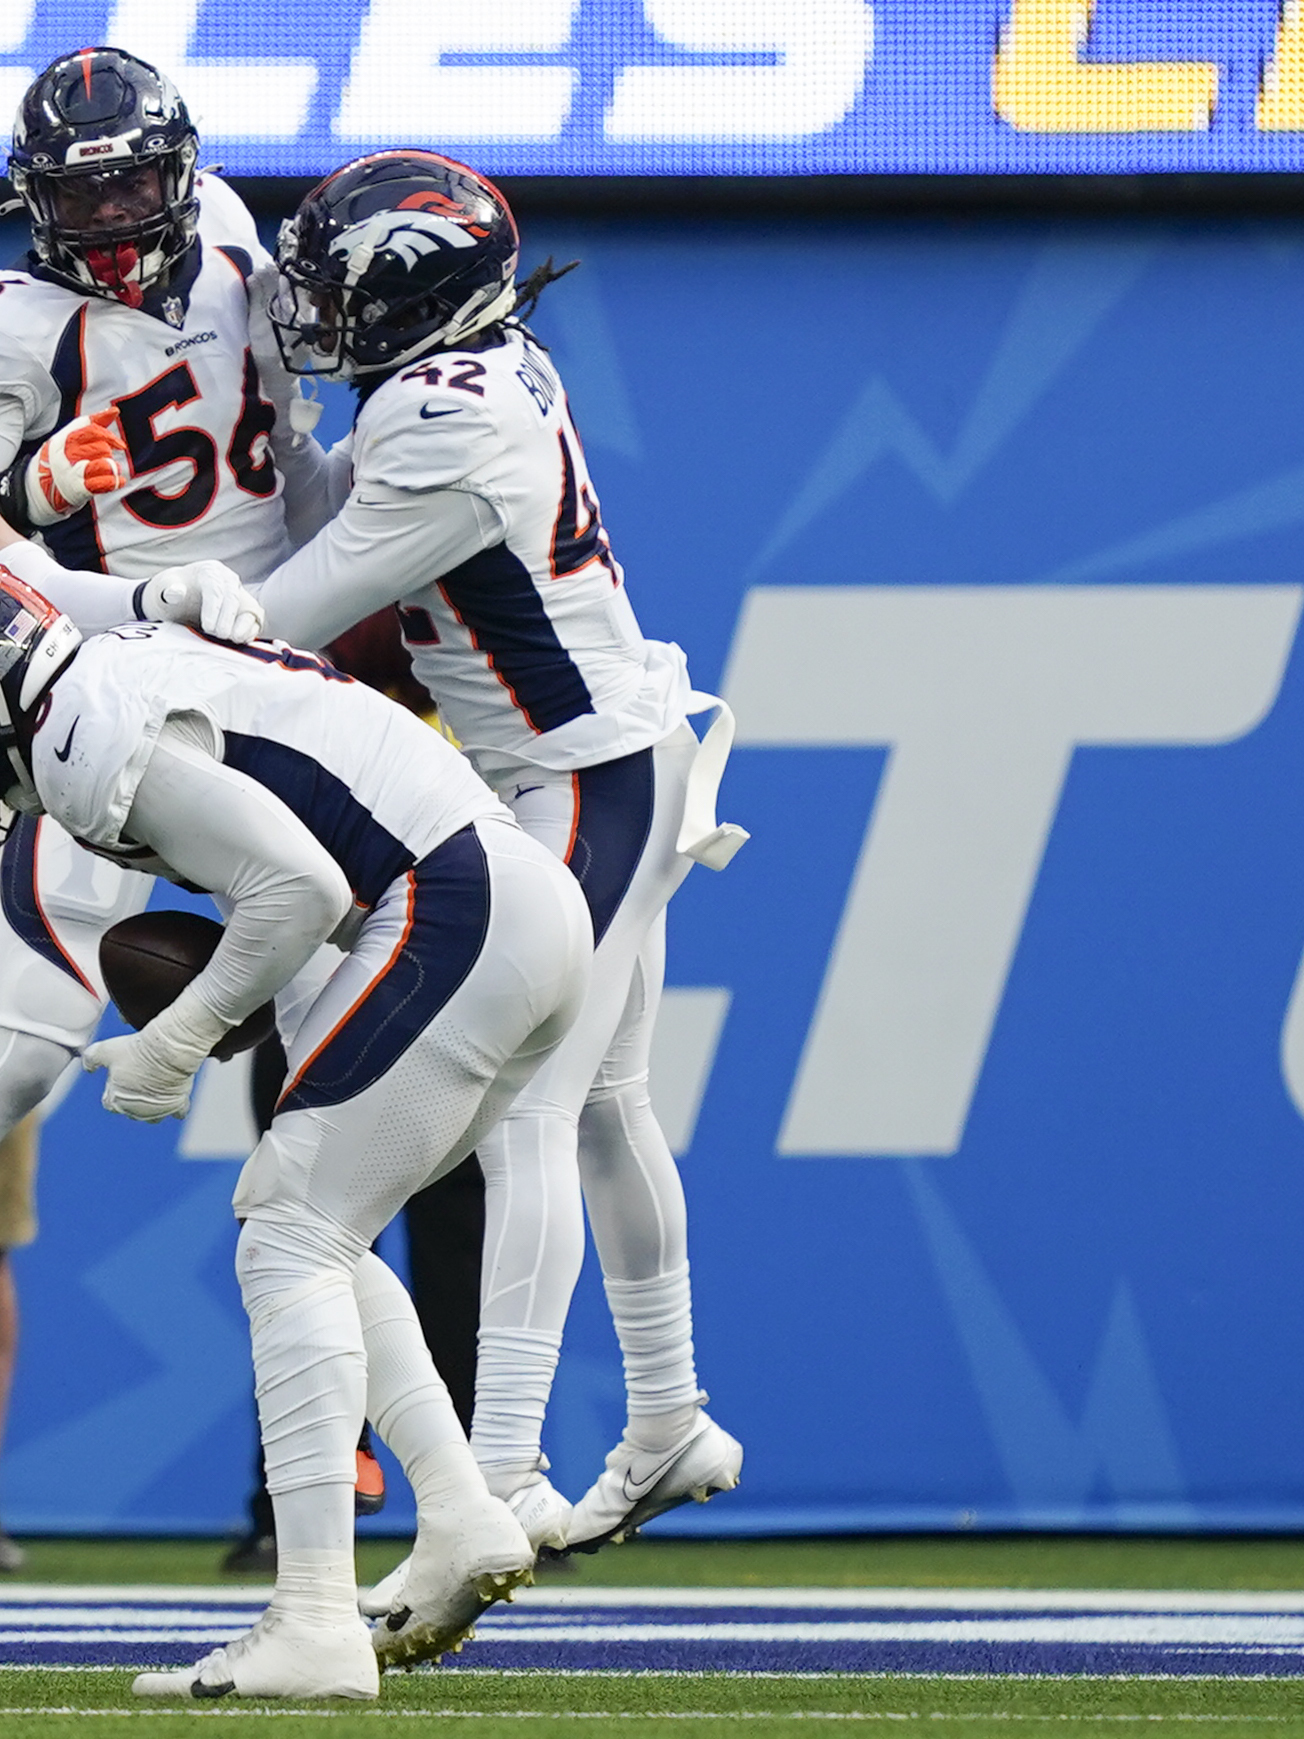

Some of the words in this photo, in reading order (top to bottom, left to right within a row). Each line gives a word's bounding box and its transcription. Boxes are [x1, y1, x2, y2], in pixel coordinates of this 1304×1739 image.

[164, 330, 219, 357] BRONCOS
[400, 359, 487, 397] 42
[108, 346, 277, 530] 56
